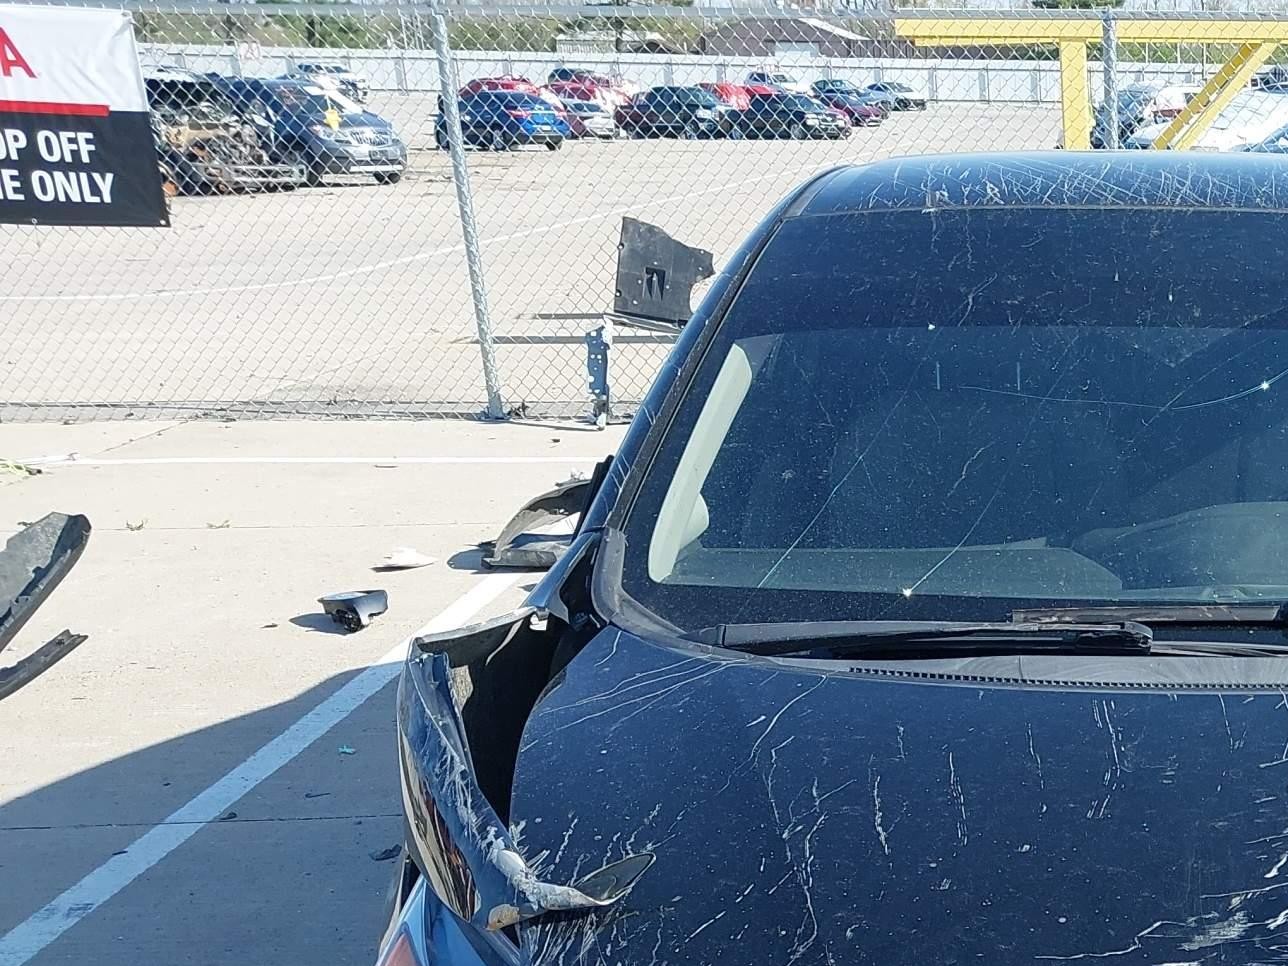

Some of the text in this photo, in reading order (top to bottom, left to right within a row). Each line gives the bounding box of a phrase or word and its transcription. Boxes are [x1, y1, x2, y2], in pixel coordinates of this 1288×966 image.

[36, 130, 96, 164] OFF
[0, 168, 114, 204] E ONLY
